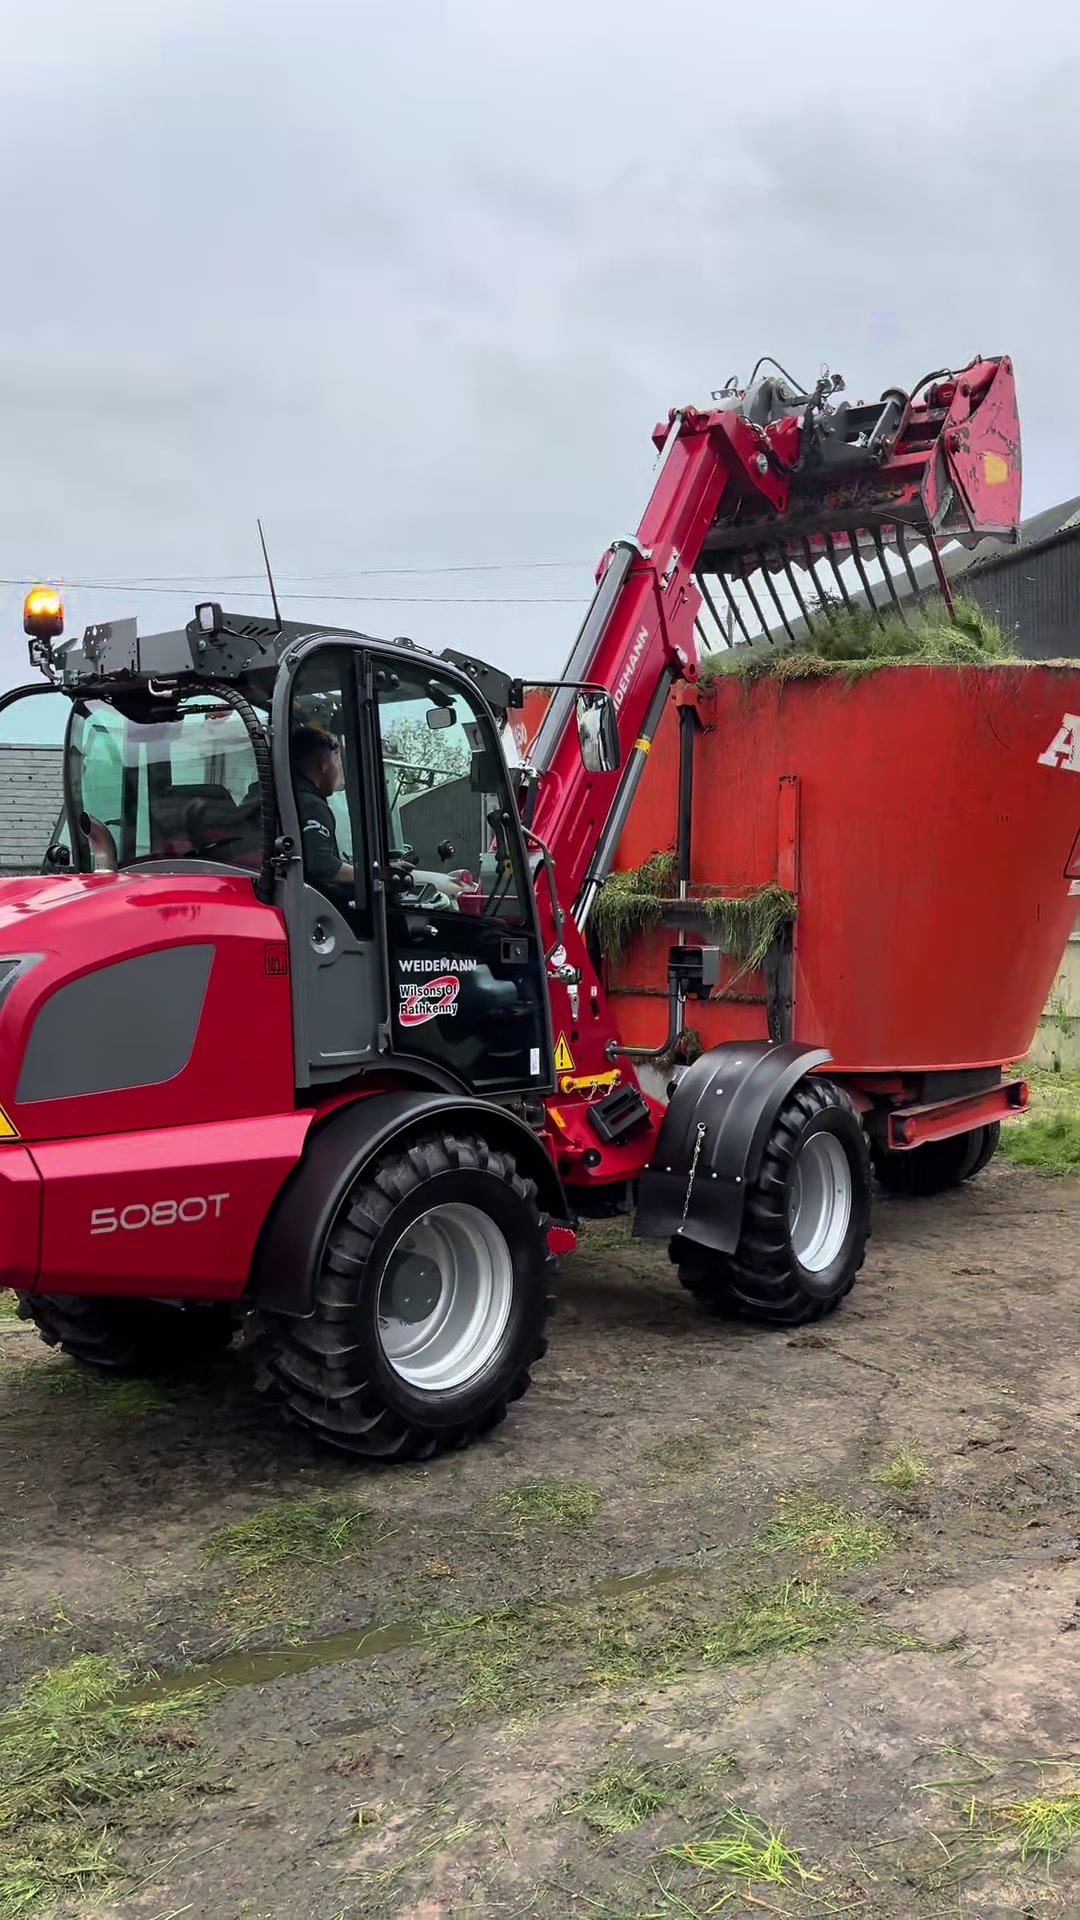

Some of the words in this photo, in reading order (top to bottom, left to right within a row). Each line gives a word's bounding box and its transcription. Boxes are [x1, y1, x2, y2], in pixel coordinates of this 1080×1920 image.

[613, 625, 649, 713] IDEMANN
[399, 959, 477, 972] WEIDEMANN
[400, 984, 442, 998] Wilsons
[445, 983, 458, 996] Of
[400, 1002, 458, 1016] Rathkenny
[90, 1192, 230, 1235] 5080T
